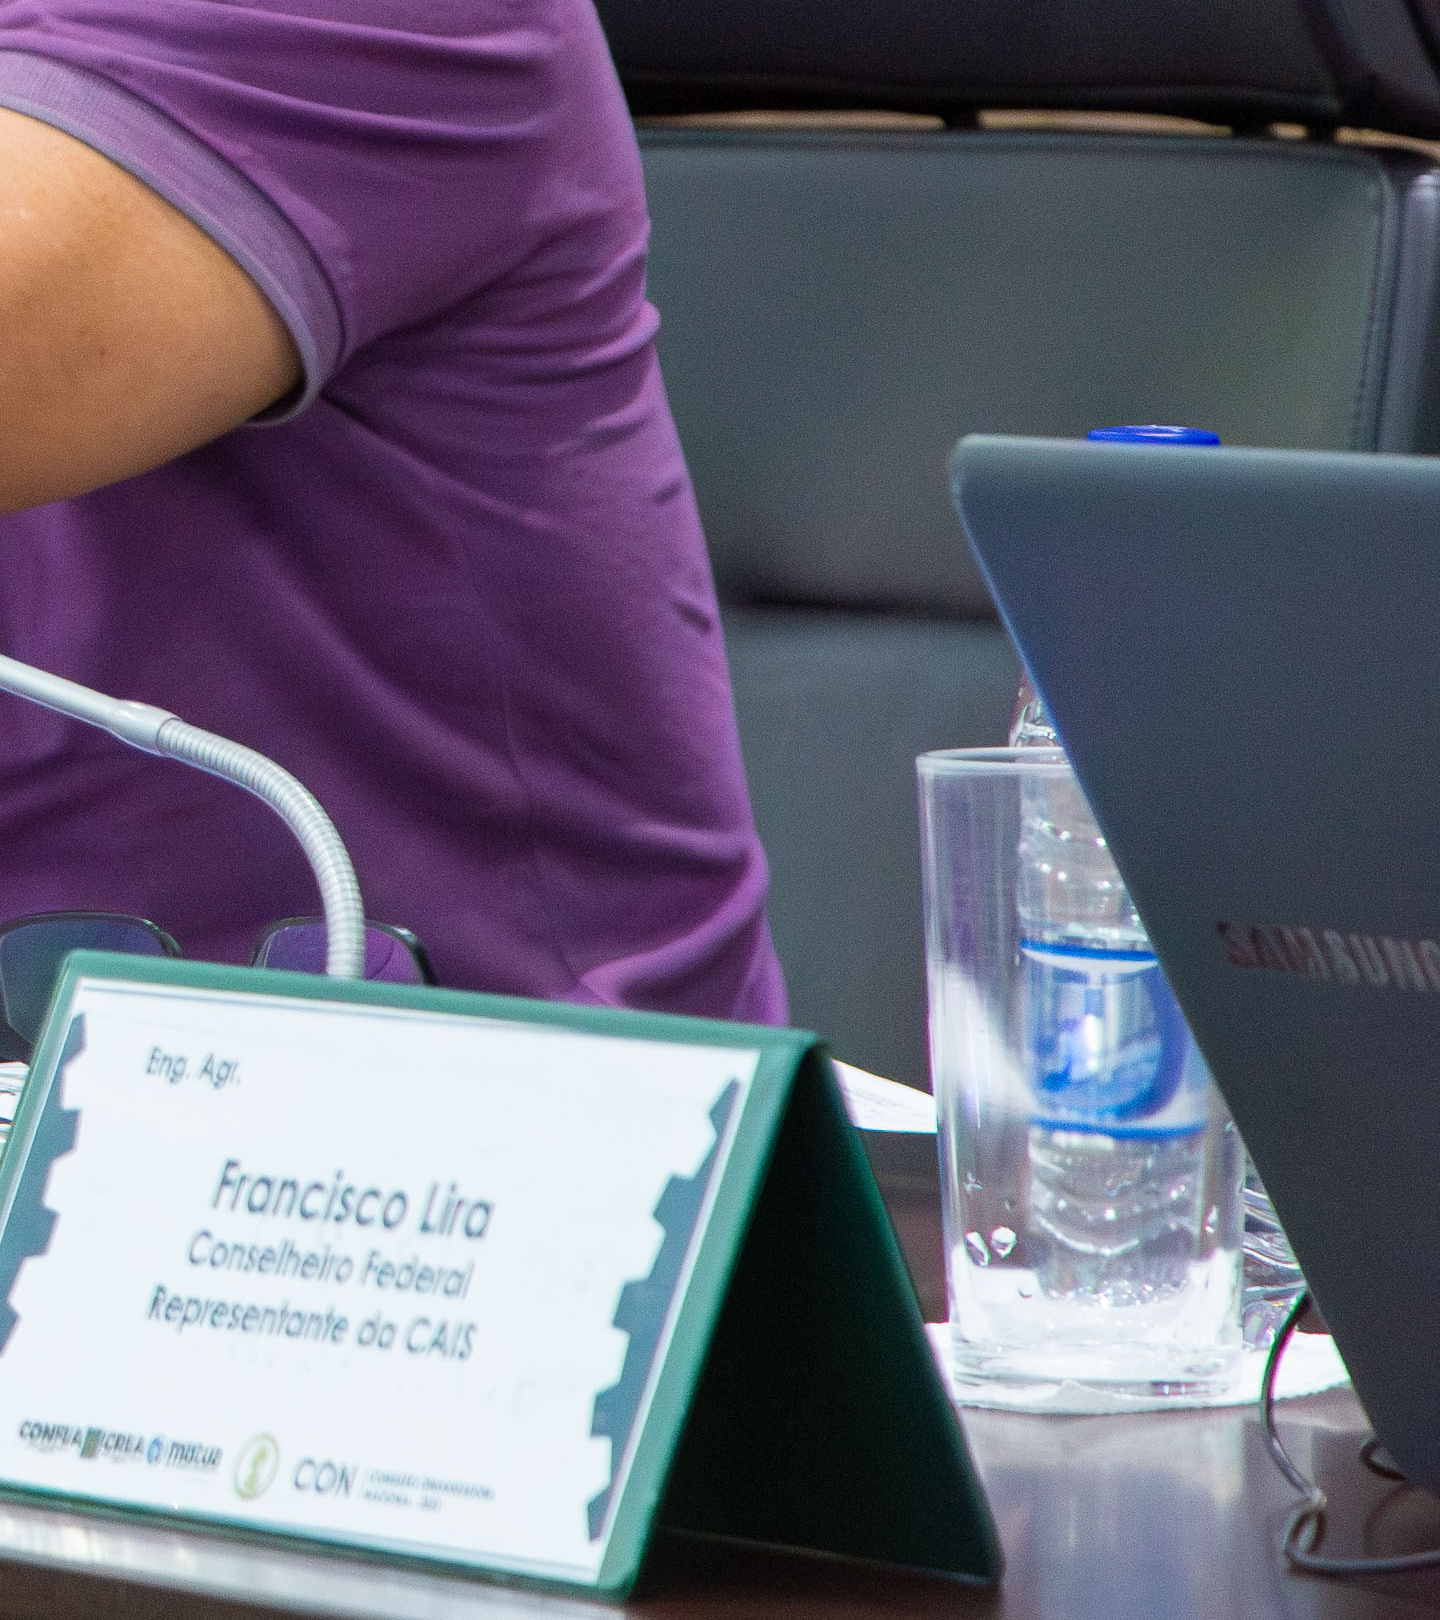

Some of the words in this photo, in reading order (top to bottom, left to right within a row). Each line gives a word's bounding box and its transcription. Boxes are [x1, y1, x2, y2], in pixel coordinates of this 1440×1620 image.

[146, 1045, 189, 1084] Eng.
[198, 1051, 241, 1090] Agr.
[212, 1158, 408, 1229] Francisco
[419, 1180, 495, 1240] Lira
[187, 1229, 355, 1284] Conselheiro
[363, 1249, 476, 1300] Federal
[148, 1283, 350, 1345] Representante
[406, 1316, 477, 1361] CAIS
[294, 1456, 358, 1497] CON
